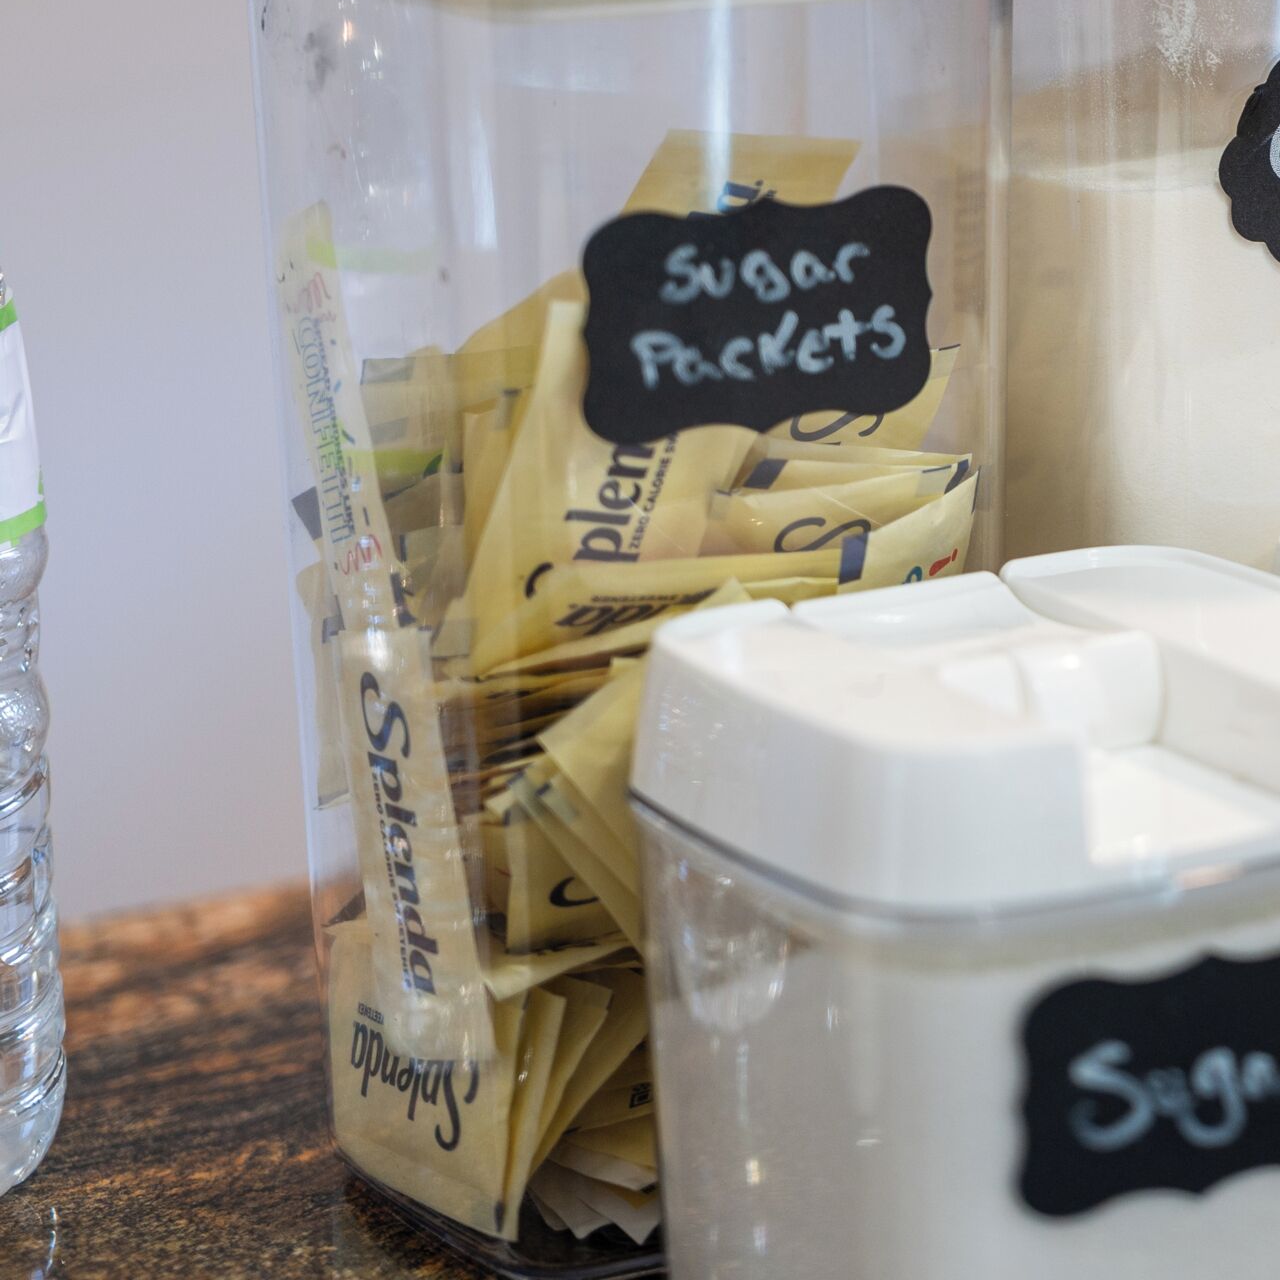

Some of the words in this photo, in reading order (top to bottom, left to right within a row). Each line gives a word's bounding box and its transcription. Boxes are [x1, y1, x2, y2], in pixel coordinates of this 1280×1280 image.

[659, 242, 871, 304] Sugar
[630, 304, 907, 391] Packets
[642, 456, 672, 513] CALORIE
[360, 671, 440, 996] Splenda
